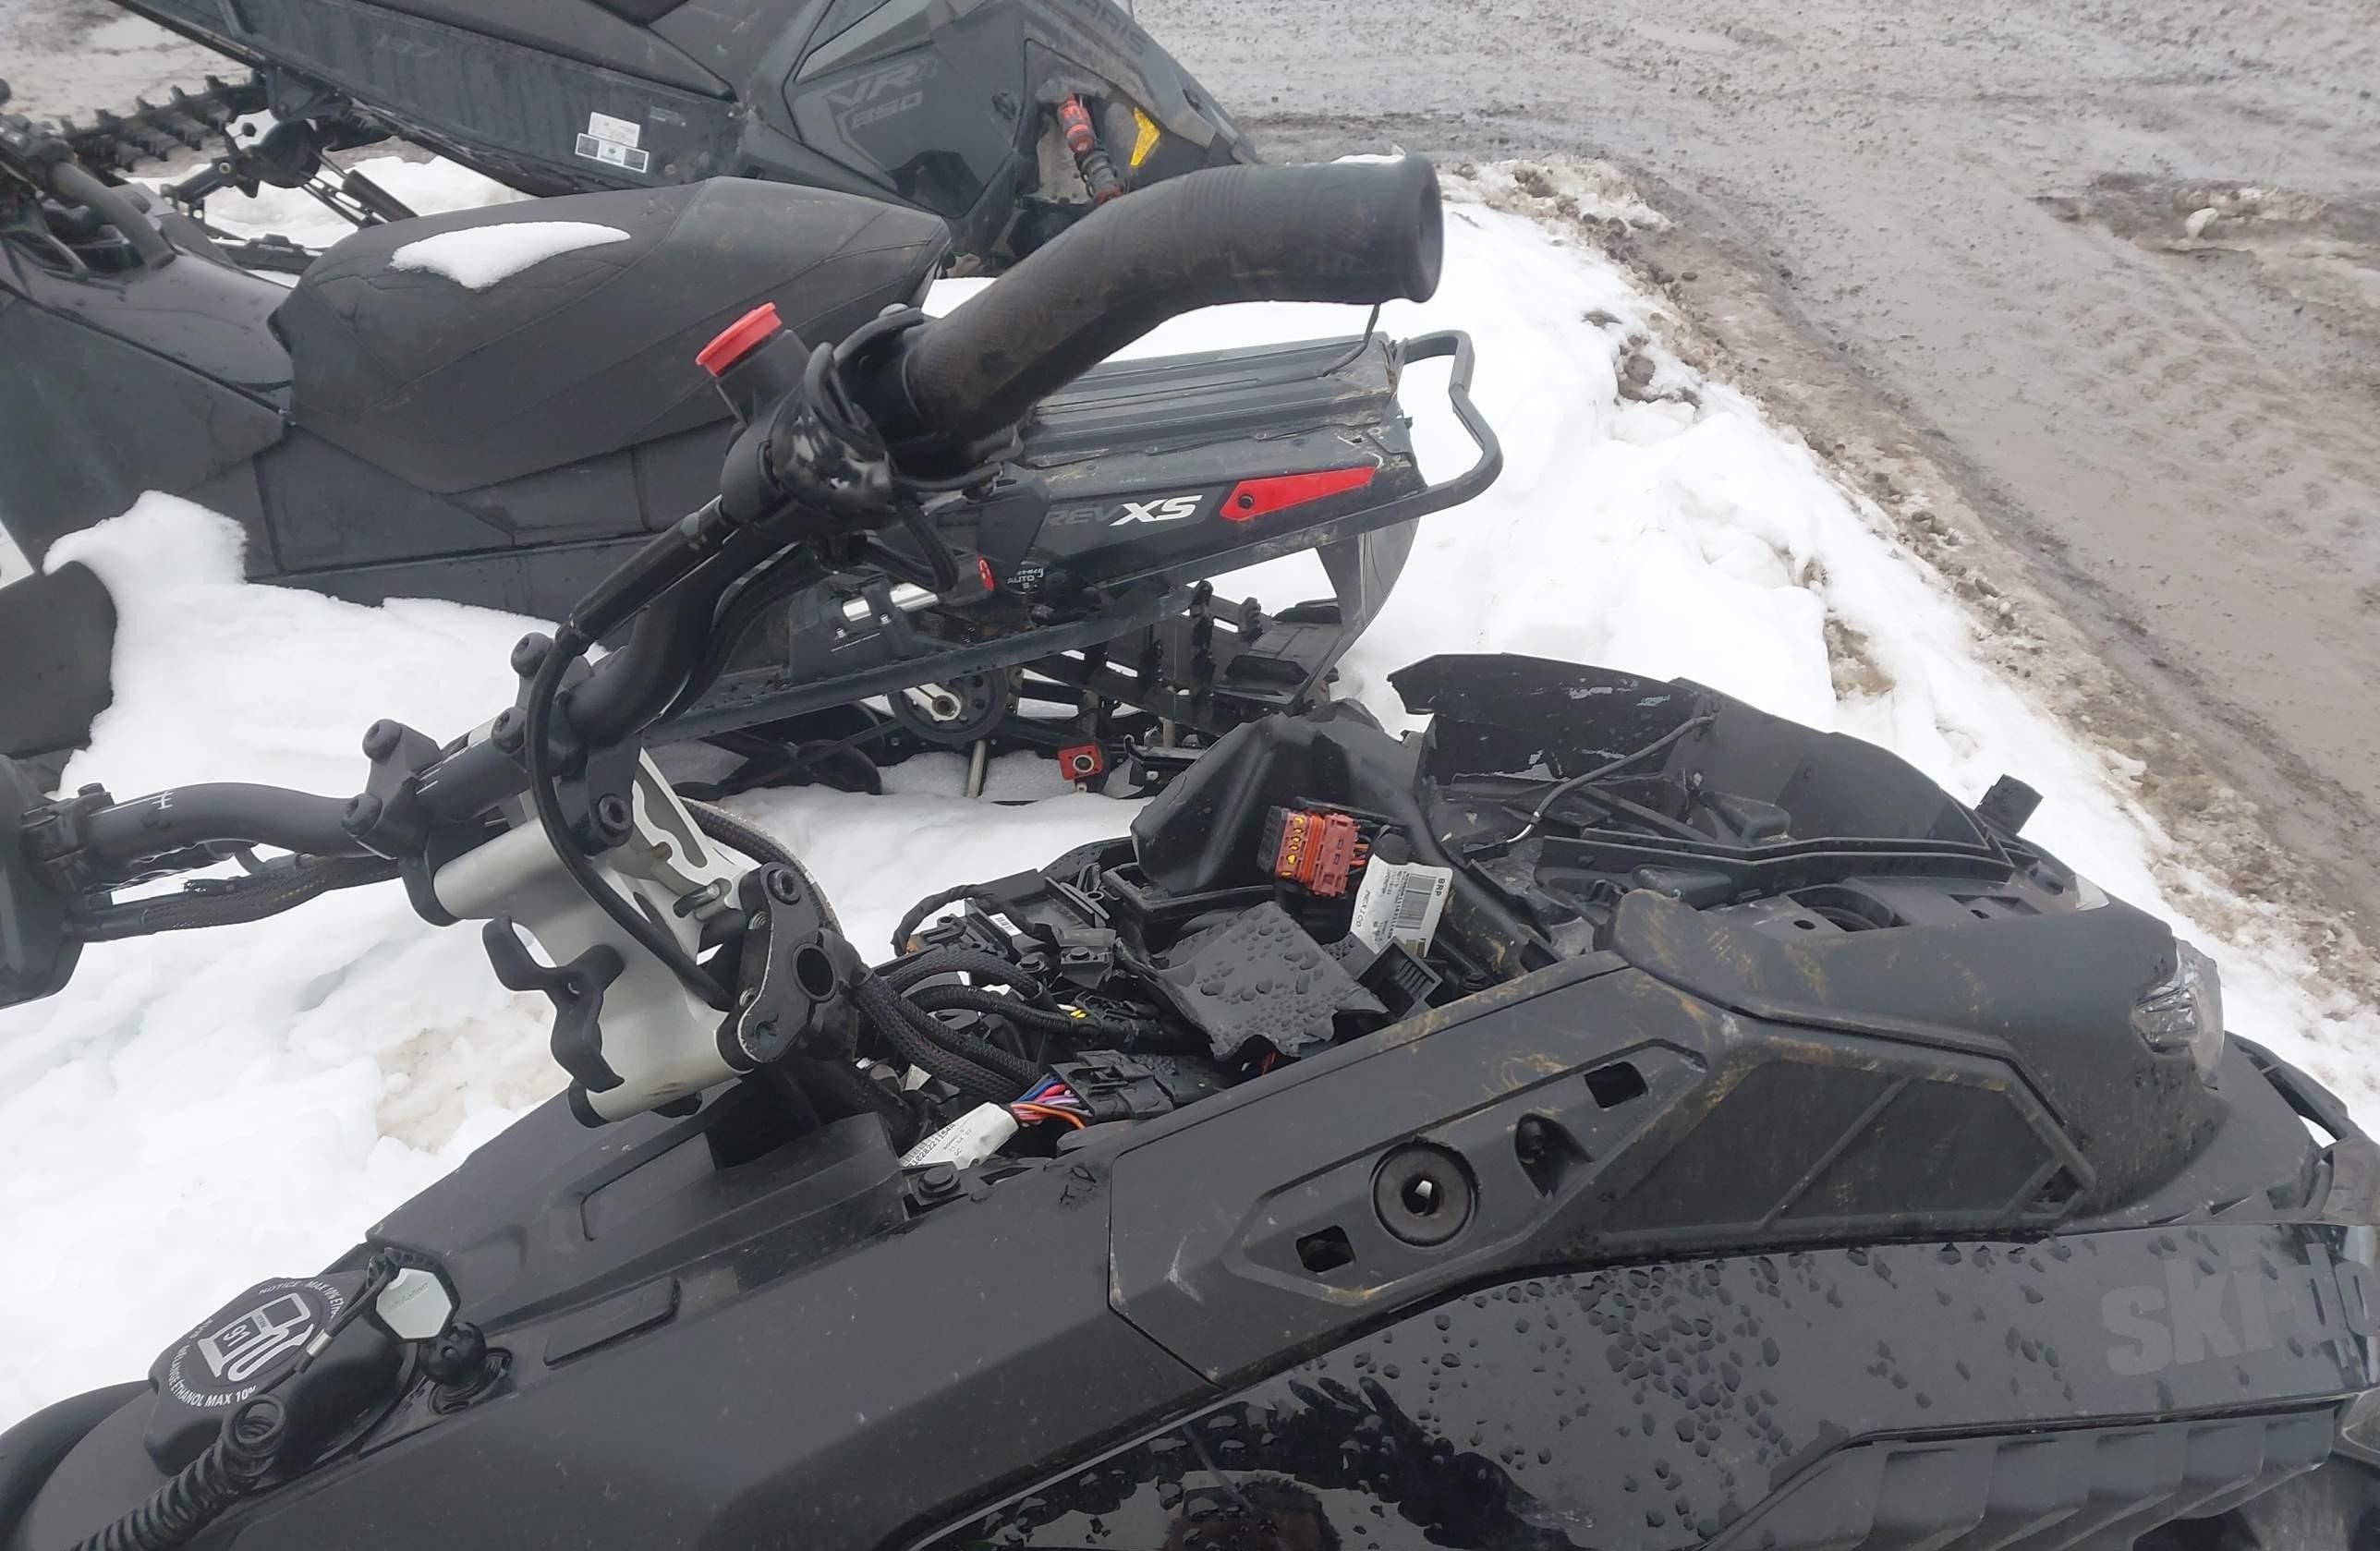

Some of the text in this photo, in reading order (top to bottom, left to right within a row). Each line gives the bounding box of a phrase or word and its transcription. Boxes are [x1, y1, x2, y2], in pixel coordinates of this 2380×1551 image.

[850, 90, 924, 130] 850
[1435, 878, 1446, 897] BRP
[258, 1280, 301, 1296] NOTICE
[223, 1324, 251, 1348] 91
[204, 1391, 233, 1408] MAX
